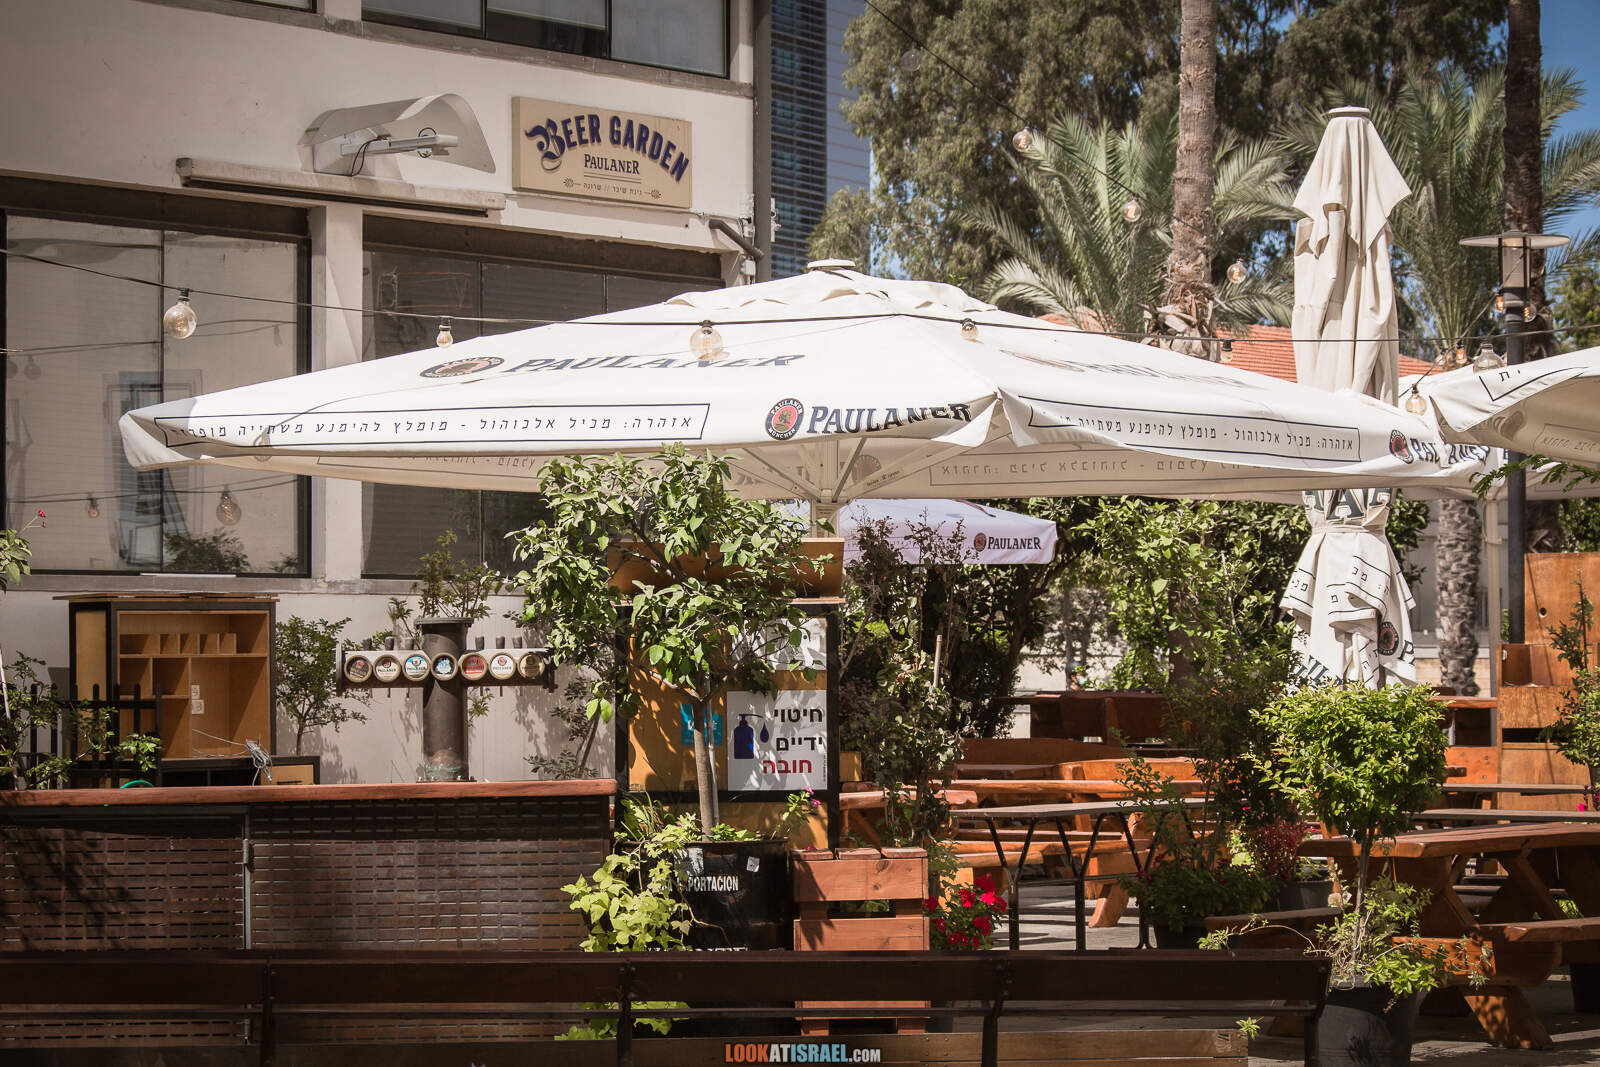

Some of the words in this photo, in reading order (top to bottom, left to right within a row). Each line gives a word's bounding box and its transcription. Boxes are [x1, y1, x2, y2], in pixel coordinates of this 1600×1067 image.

[524, 113, 602, 172] BEER
[609, 115, 690, 184] GARDEN
[584, 153, 640, 175] PAULANER
[502, 354, 806, 373] PAULANER
[481, 418, 556, 430] אלכוהול
[570, 417, 611, 429] מכיל
[623, 417, 692, 429] אזהרה:
[807, 403, 972, 434] PAULANER
[1078, 417, 1122, 432] משתייה
[239, 423, 303, 436] משתייה
[316, 422, 381, 433] להימנע
[394, 421, 448, 434] מומלץ
[1130, 421, 1173, 436] להימנע
[1181, 424, 1217, 440] מומלץ
[1235, 428, 1280, 444] אלכוהול
[1287, 431, 1311, 447] מכיל
[1317, 437, 1353, 450] אזהרה:
[987, 537, 1042, 550] PAULANER
[773, 708, 823, 723] חיטוי
[776, 736, 823, 752] ידיים
[762, 759, 812, 774] חובה
[676, 875, 739, 892] PORTACION
